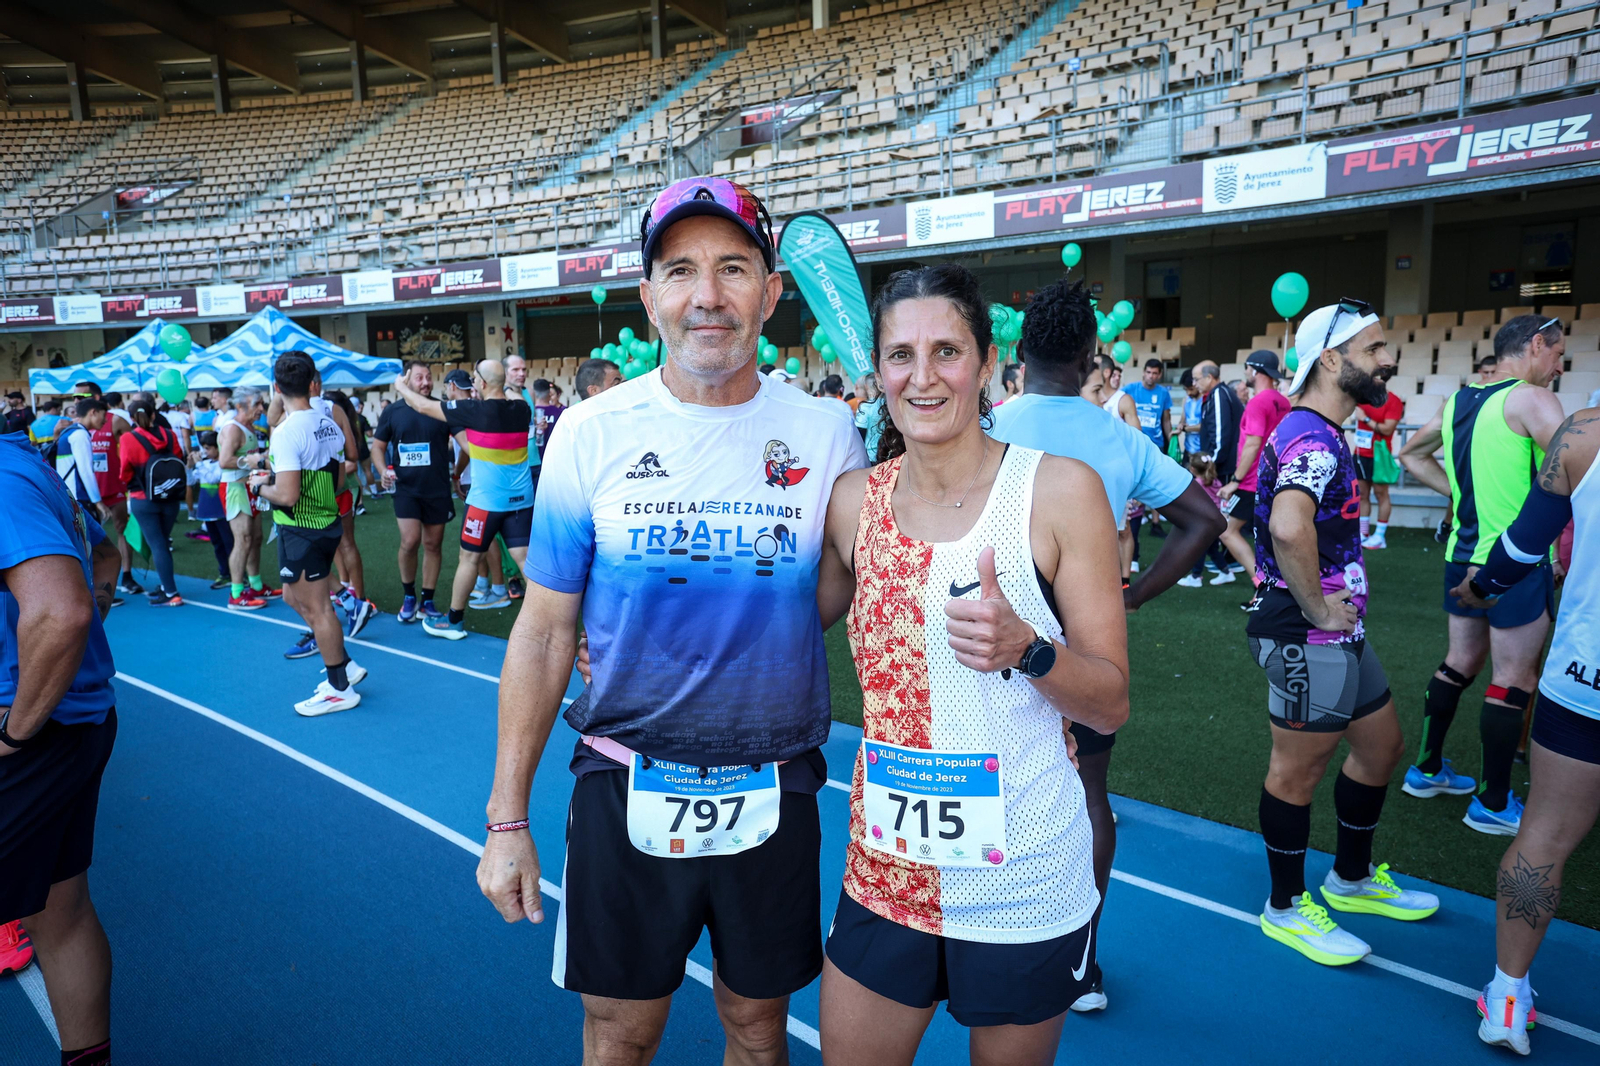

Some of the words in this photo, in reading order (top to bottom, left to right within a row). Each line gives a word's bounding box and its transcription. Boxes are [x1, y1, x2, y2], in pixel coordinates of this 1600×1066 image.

[1343, 138, 1449, 176] PLAY
[1427, 113, 1593, 177] JEREZ
[1244, 165, 1313, 182] Ayuntamiento
[1244, 182, 1255, 191] de
[1257, 179, 1282, 191] Jerez
[1005, 194, 1075, 220] PLAY
[1062, 181, 1166, 223] JEREZ
[936, 211, 986, 222] Ayuntamiento
[836, 219, 880, 240] REZ
[946, 221, 964, 230] Jerez
[565, 256, 607, 274] PLAY
[601, 249, 642, 277] JER
[399, 275, 437, 290] PLAY
[431, 269, 484, 294] JEREZ
[251, 289, 285, 303] PLAY
[279, 284, 327, 307] JEREZ
[107, 300, 142, 313] PLAY
[136, 295, 183, 317] JEREZ
[406, 453, 423, 461] 489
[624, 502, 697, 515] ESCUELA
[737, 735, 772, 744] cuchara
[705, 746, 741, 754] entrega
[743, 747, 776, 755] entrega
[654, 760, 676, 771] XLIII
[679, 765, 718, 774] Carrra
[878, 748, 896, 761] XLIII
[897, 752, 933, 767] Carrera
[935, 757, 983, 770] Popular
[664, 774, 701, 785] Ciudad
[704, 777, 718, 786] de
[720, 773, 748, 785] Jerez
[886, 765, 917, 780] Ciudad
[918, 770, 933, 782] de
[935, 773, 968, 783] Jerez
[906, 781, 933, 791] Noviembre
[665, 796, 746, 833] 797
[888, 792, 965, 840] 715
